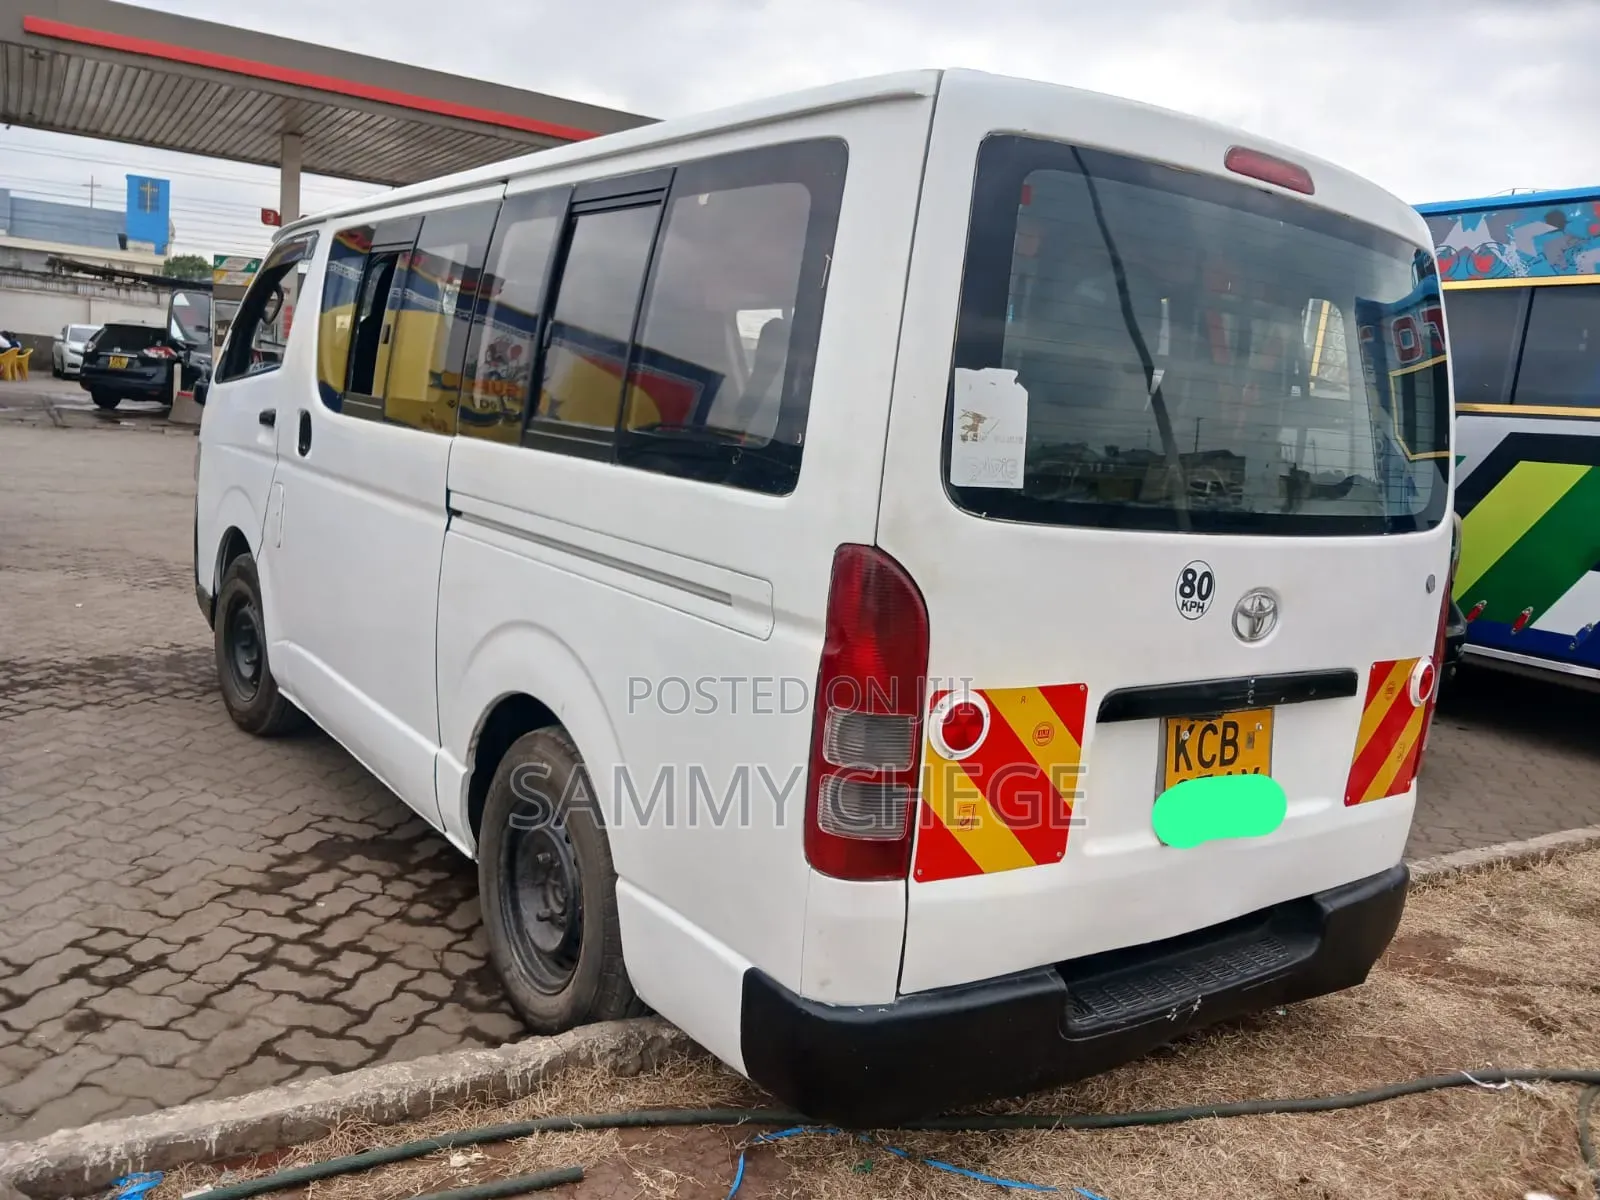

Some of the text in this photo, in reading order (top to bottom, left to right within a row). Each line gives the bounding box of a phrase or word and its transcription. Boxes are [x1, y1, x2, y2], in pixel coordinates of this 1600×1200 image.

[1179, 568, 1213, 601] 80
[1181, 600, 1205, 613] KPH
[1174, 721, 1240, 773] KCB
